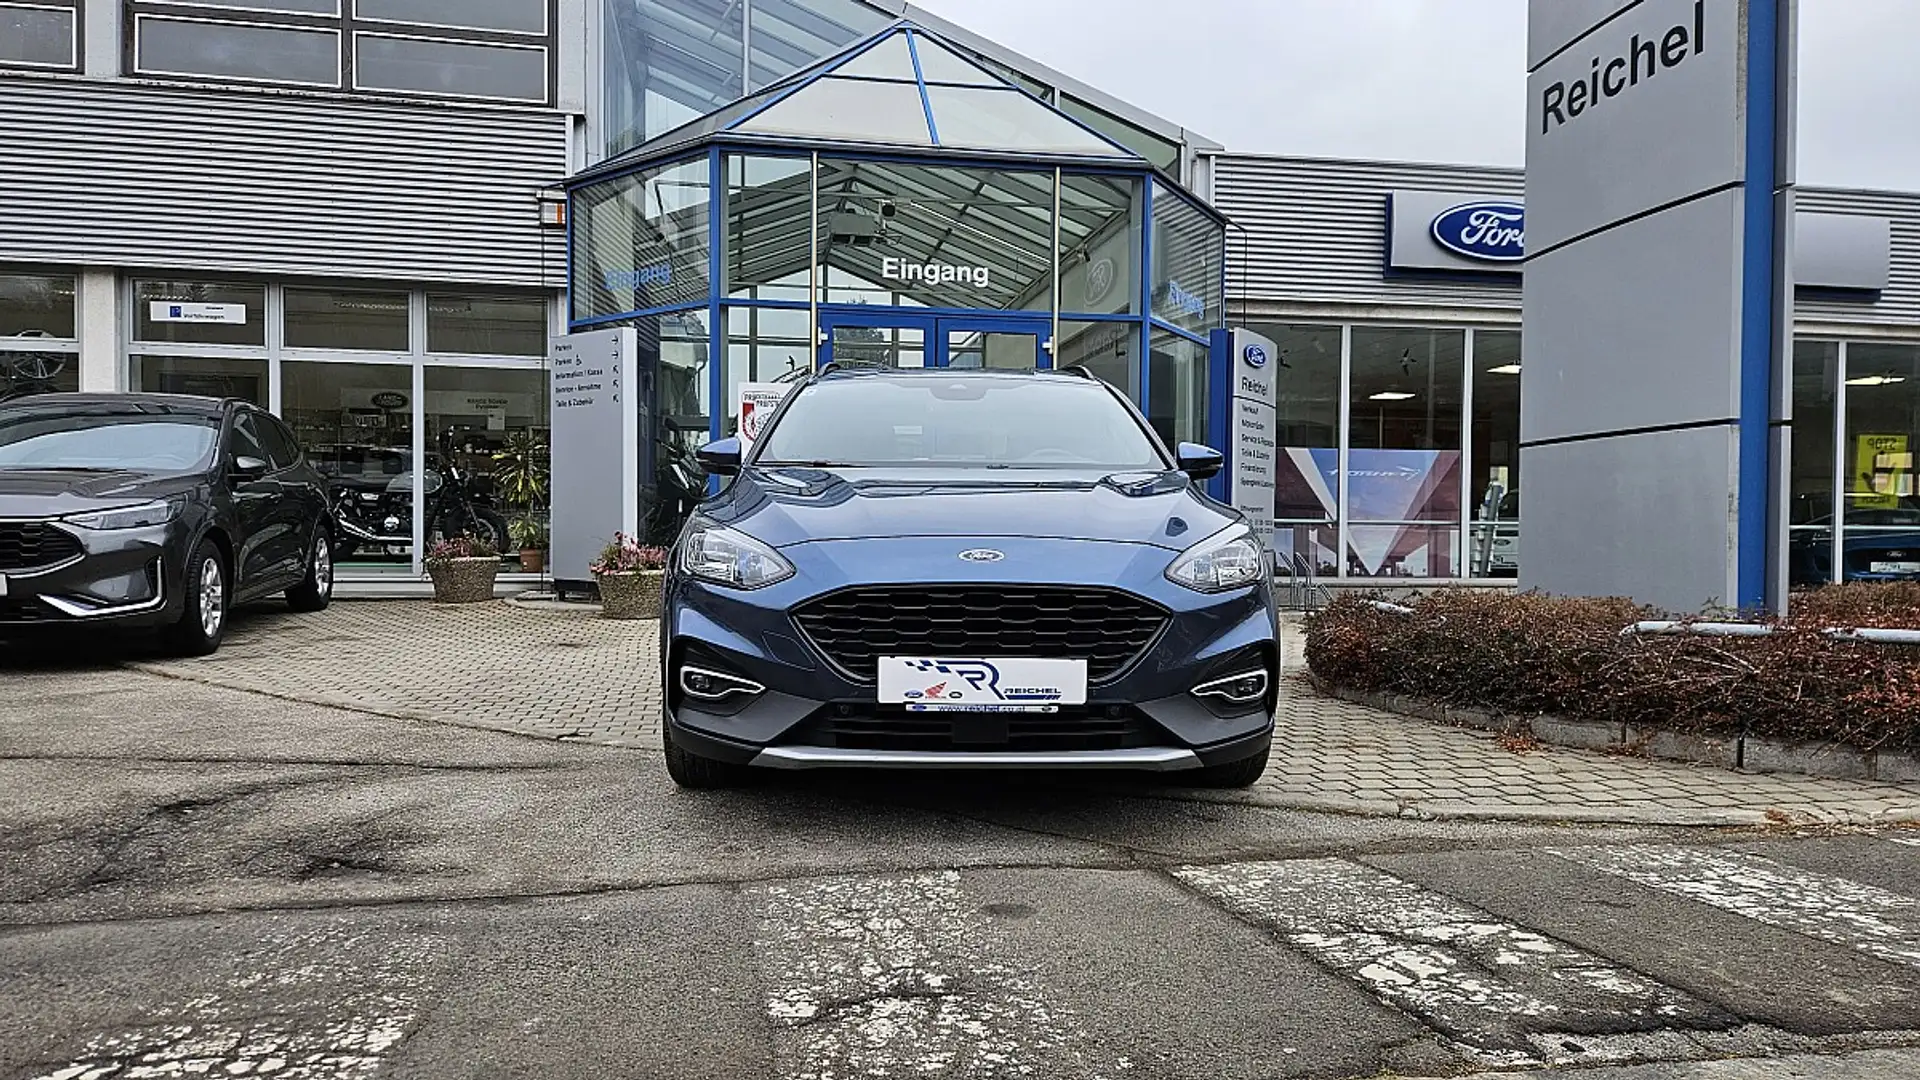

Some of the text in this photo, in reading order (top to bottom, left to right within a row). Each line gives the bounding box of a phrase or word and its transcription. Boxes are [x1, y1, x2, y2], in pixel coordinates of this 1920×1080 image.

[1542, 1, 1704, 135] Reichel
[882, 257, 988, 288] Eingang
[1241, 376, 1268, 397] Reichel
